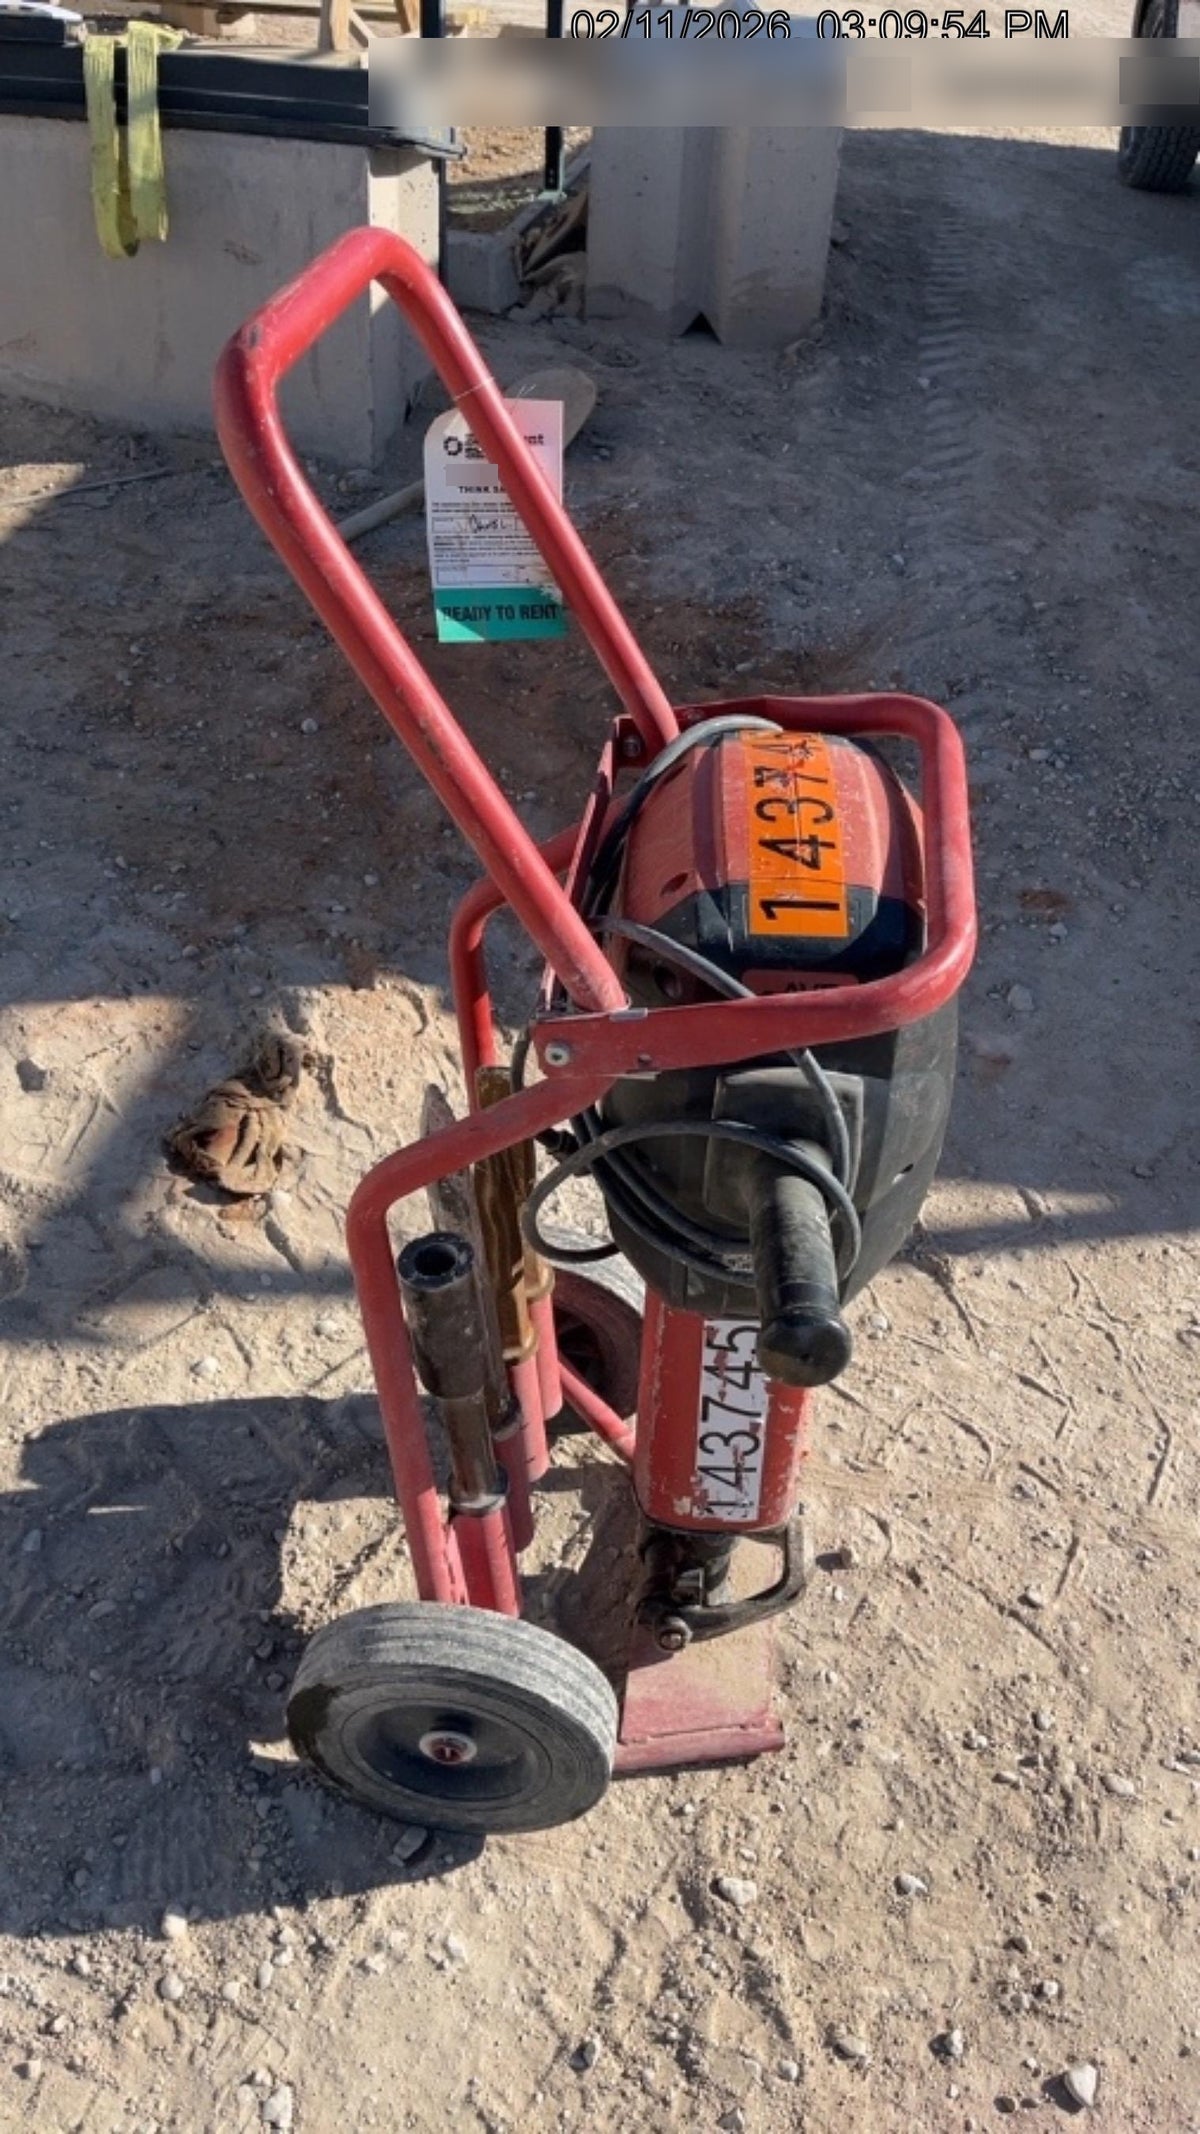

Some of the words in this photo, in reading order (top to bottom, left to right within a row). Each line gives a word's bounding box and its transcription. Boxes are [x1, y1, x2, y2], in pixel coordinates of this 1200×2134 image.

[441, 605, 492, 621] READY
[496, 604, 515, 620] TO
[519, 603, 557, 620] RENT
[752, 734, 841, 921] 14374
